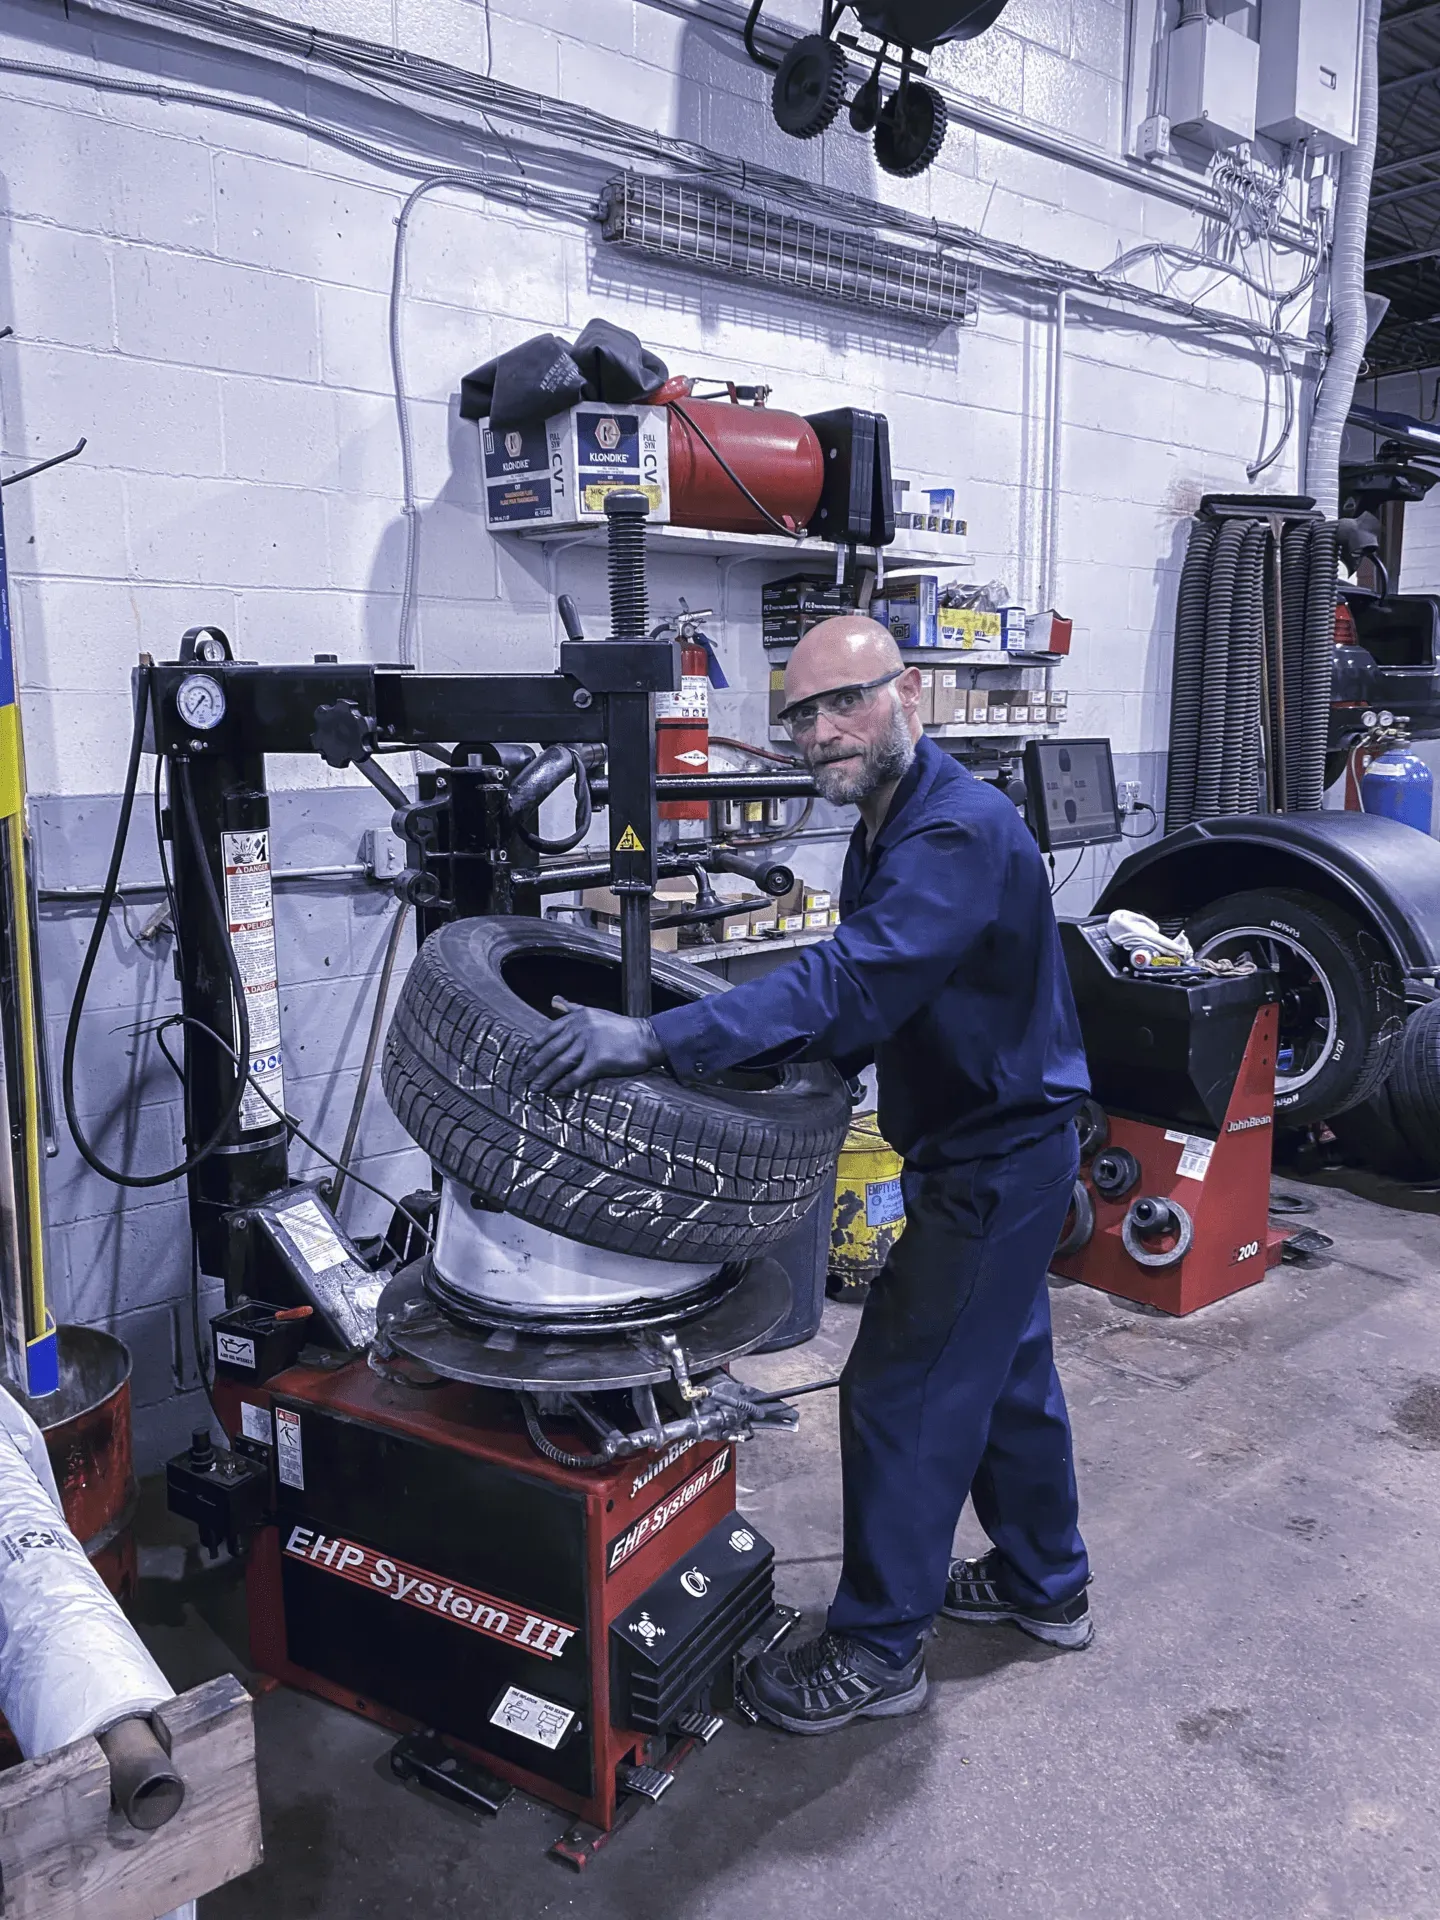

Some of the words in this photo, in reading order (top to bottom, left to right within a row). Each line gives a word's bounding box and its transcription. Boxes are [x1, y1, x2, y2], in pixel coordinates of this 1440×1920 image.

[550, 432, 560, 441] FULL
[643, 434, 656, 442] FULL
[644, 441, 656, 450] SYN
[589, 452, 629, 463] KLONDIKE
[502, 459, 530, 472] KLONDIKE
[643, 454, 658, 484] CV
[552, 453, 565, 497] CVT
[243, 863, 269, 873] DANGER
[246, 919, 273, 930] PELIGRO
[1270, 919, 1300, 938] FUSION
[250, 980, 276, 993] DANGER
[1226, 1115, 1272, 1133] JohnBean
[868, 1183, 890, 1195] EMPTY
[1237, 1241, 1259, 1262] 200
[630, 1438, 698, 1498] JohnBea
[609, 1517, 650, 1569] EHP
[651, 1472, 708, 1531] System
[709, 1448, 730, 1482] III
[285, 1525, 365, 1571] EHP
[369, 1558, 510, 1634] System
[514, 1614, 575, 1657] III
